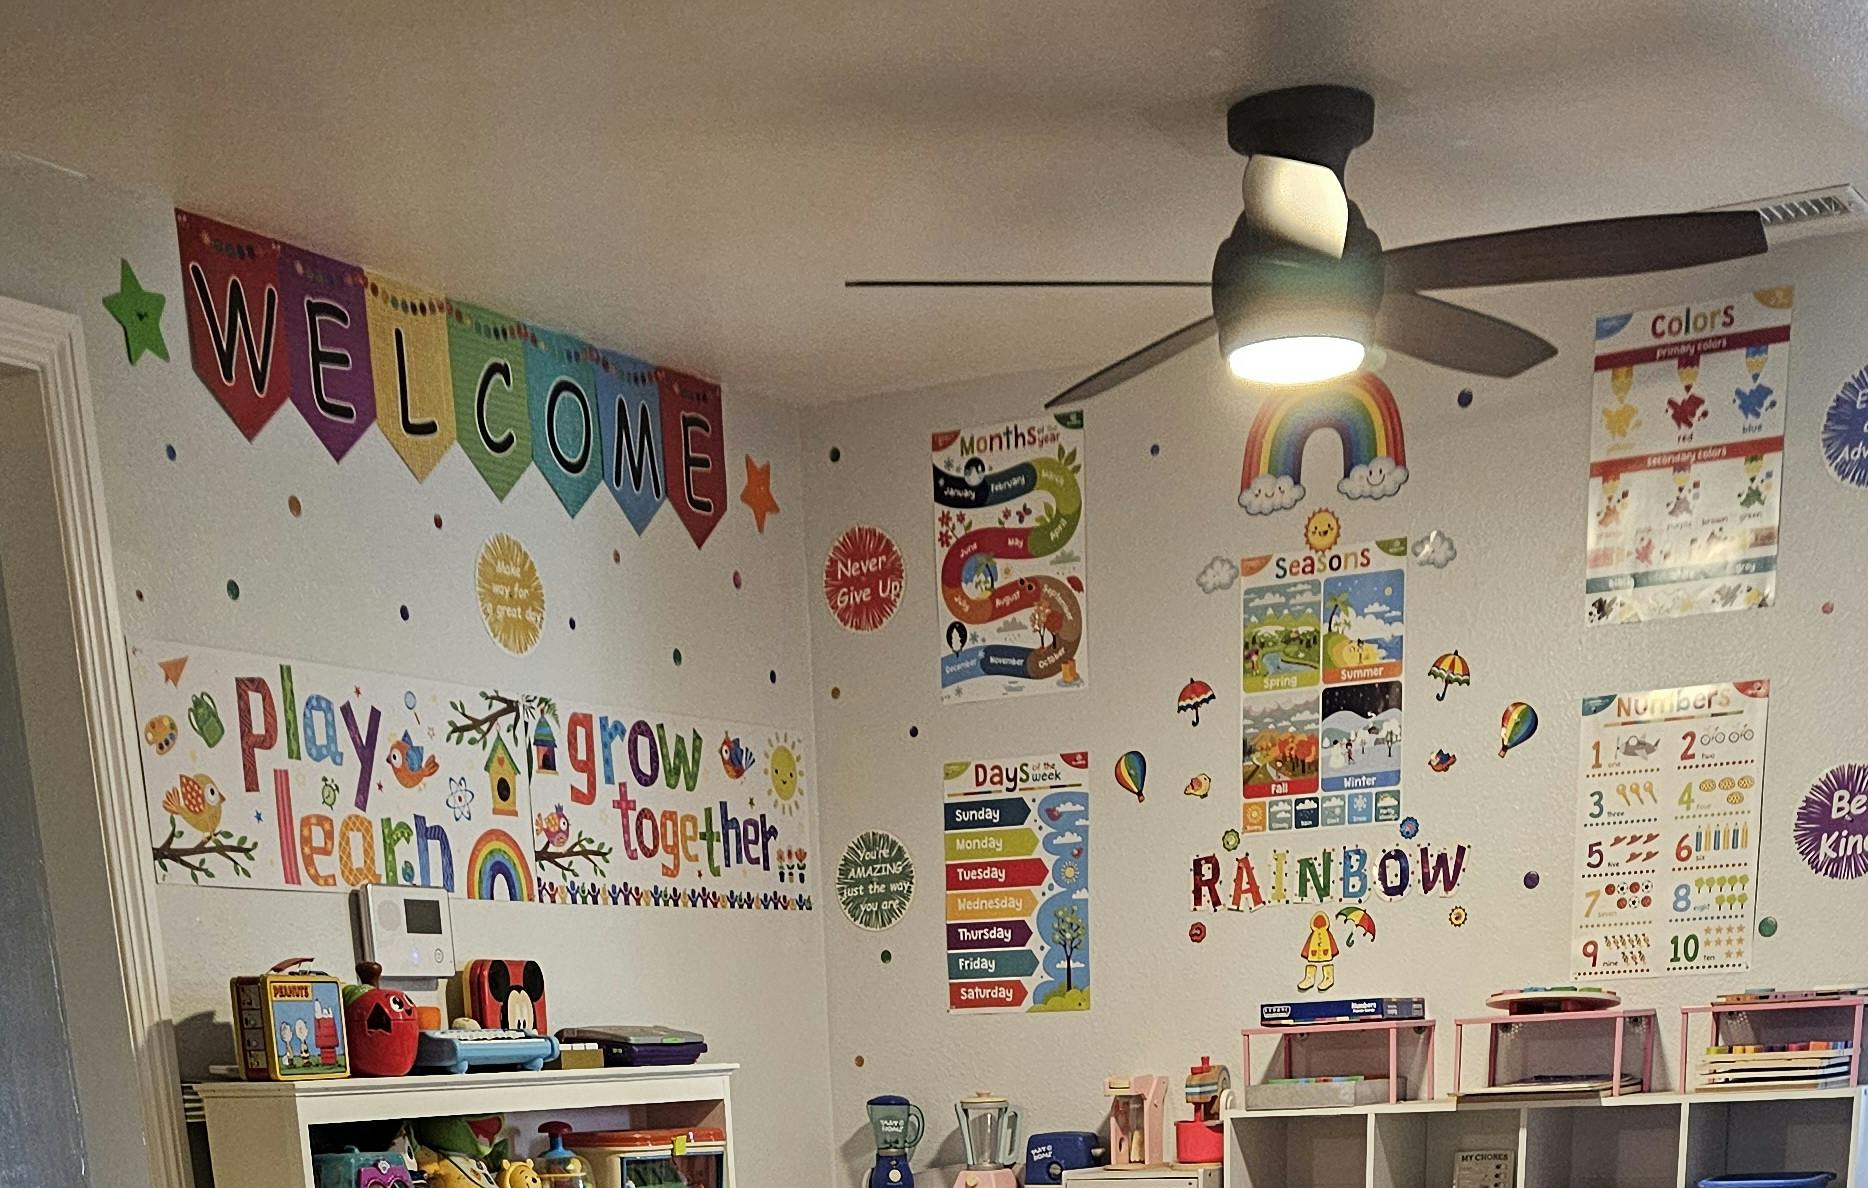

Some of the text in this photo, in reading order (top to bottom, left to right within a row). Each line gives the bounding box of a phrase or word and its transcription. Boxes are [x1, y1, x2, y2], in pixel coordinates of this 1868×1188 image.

[1651, 304, 1736, 340] Colors
[1656, 337, 1728, 361] primary colors
[189, 261, 714, 516] WELCOME
[1677, 433, 1694, 444] red
[1742, 424, 1763, 435] blue
[960, 424, 1035, 457] Months
[1038, 430, 1061, 448] year
[1646, 451, 1696, 468] secondary
[991, 474, 1026, 493] February
[943, 488, 976, 500] January
[959, 542, 978, 557] June
[1007, 537, 1024, 548] May
[837, 554, 886, 580] Never
[1275, 548, 1371, 579] Seasons
[837, 577, 900, 607] Give Up
[496, 605, 521, 620] great
[989, 655, 1025, 666] November
[1038, 647, 1065, 669] October
[1263, 674, 1298, 690] Spring
[1340, 665, 1385, 680] Summer
[1616, 684, 1732, 718] Numbers
[234, 664, 382, 813] play
[1680, 730, 1698, 761] 2
[567, 711, 703, 806] grow
[1591, 740, 1603, 769] 1
[1031, 770, 1062, 782] week
[1343, 775, 1378, 789] Winter
[1270, 782, 1289, 795] Fall
[1678, 782, 1695, 812] 4
[1588, 790, 1604, 819] 3
[1831, 789, 1868, 819] Be
[955, 807, 1000, 822] Sunday
[273, 768, 455, 893] learn
[612, 782, 778, 878] together
[955, 836, 1003, 850] Monday
[1675, 833, 1693, 862] 6
[1586, 841, 1604, 869] 5
[847, 861, 903, 879] AMAZING
[956, 866, 1006, 882] Tuesday
[1190, 844, 1468, 909] RAINBOW
[868, 881, 886, 895] the
[889, 880, 910, 894] way
[860, 899, 900, 914] you are
[957, 896, 1023, 911] Wednesday
[1584, 889, 1601, 918] 7
[1672, 883, 1691, 912] 8
[957, 926, 1012, 942] Thursday
[1582, 940, 1599, 967] 9
[1669, 933, 1700, 963] 10
[958, 958, 996, 973] Friday
[272, 984, 310, 998] PEANUTS
[960, 986, 1014, 1001] Saturday
[1474, 1153, 1509, 1161] CHORES
